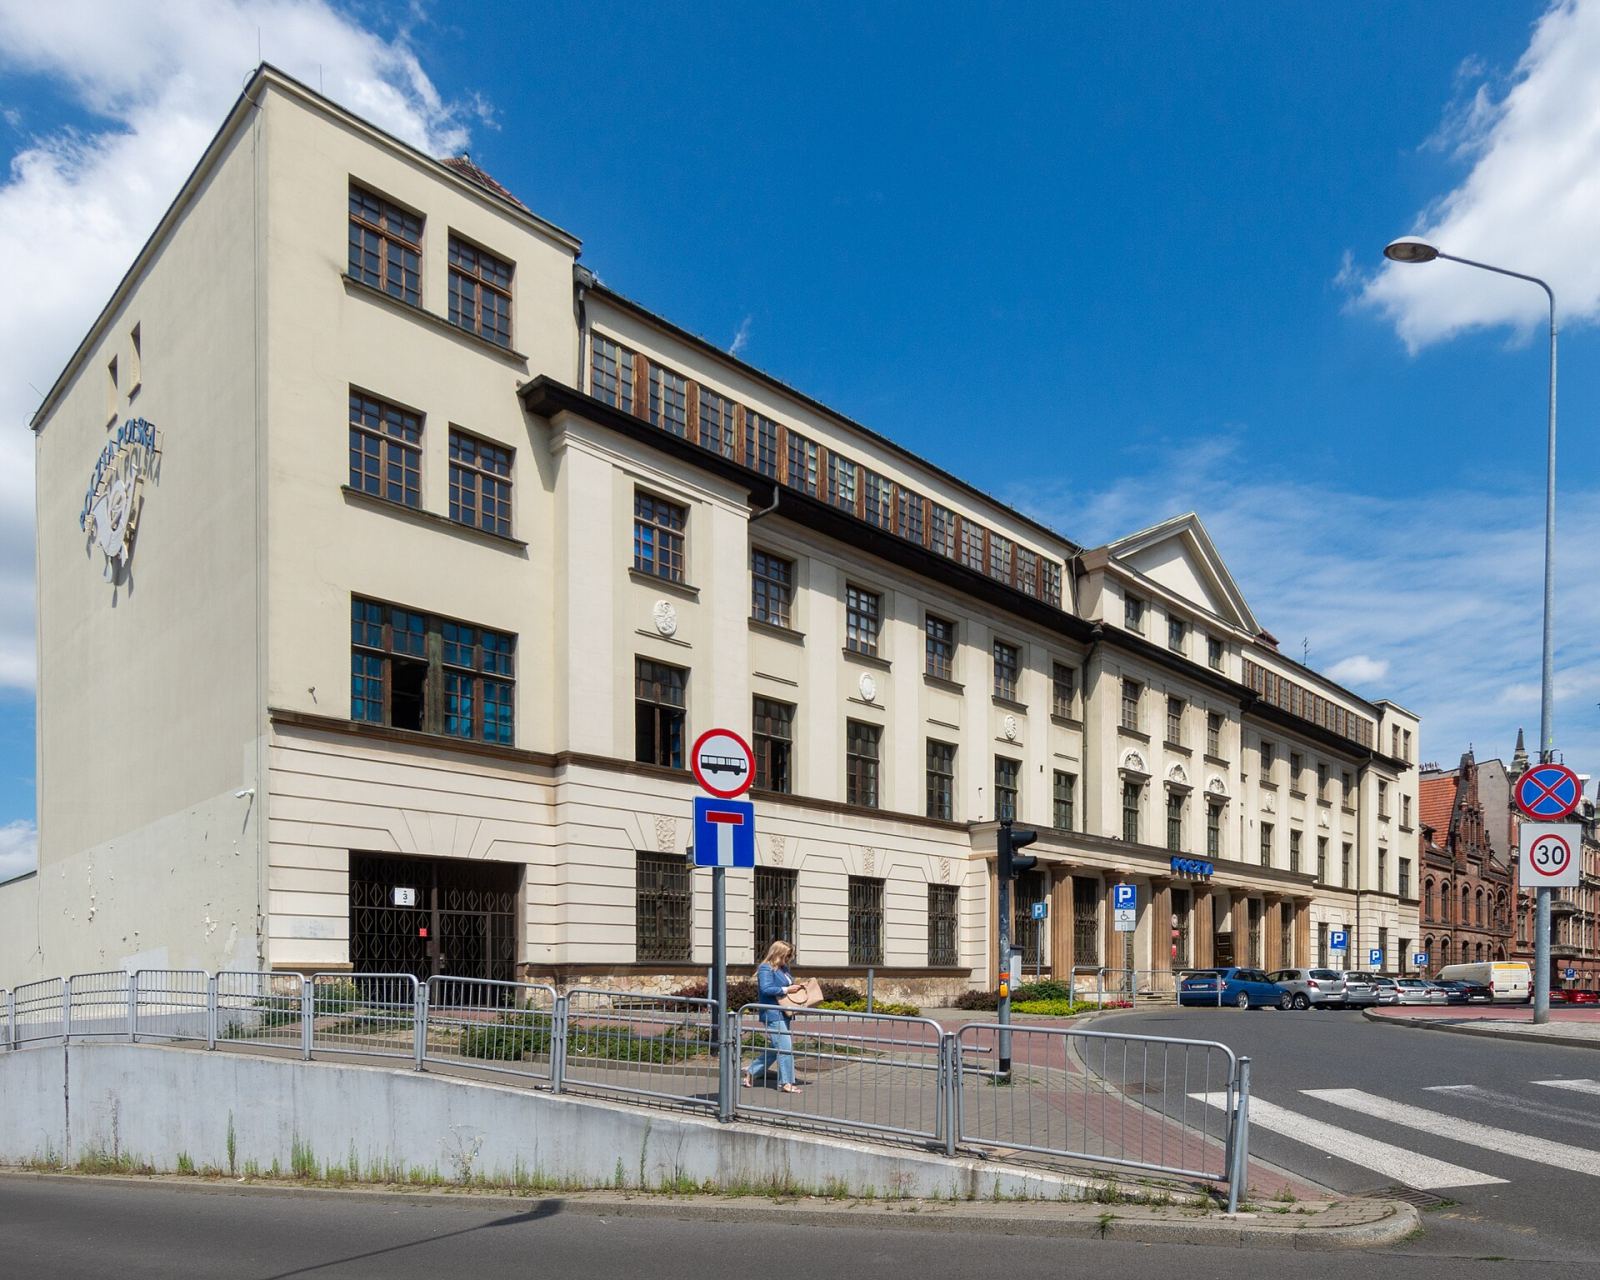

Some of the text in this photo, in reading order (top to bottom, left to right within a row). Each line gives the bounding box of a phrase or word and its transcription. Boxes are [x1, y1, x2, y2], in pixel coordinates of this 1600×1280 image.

[117, 417, 156, 452] POLSKA
[1537, 845, 1565, 865] 30
[1118, 887, 1132, 903] P
[1034, 904, 1043, 917] P
[1333, 933, 1344, 945] P
[1372, 950, 1380, 961] P
[1417, 954, 1425, 964] P
[1567, 968, 1574, 976] P
